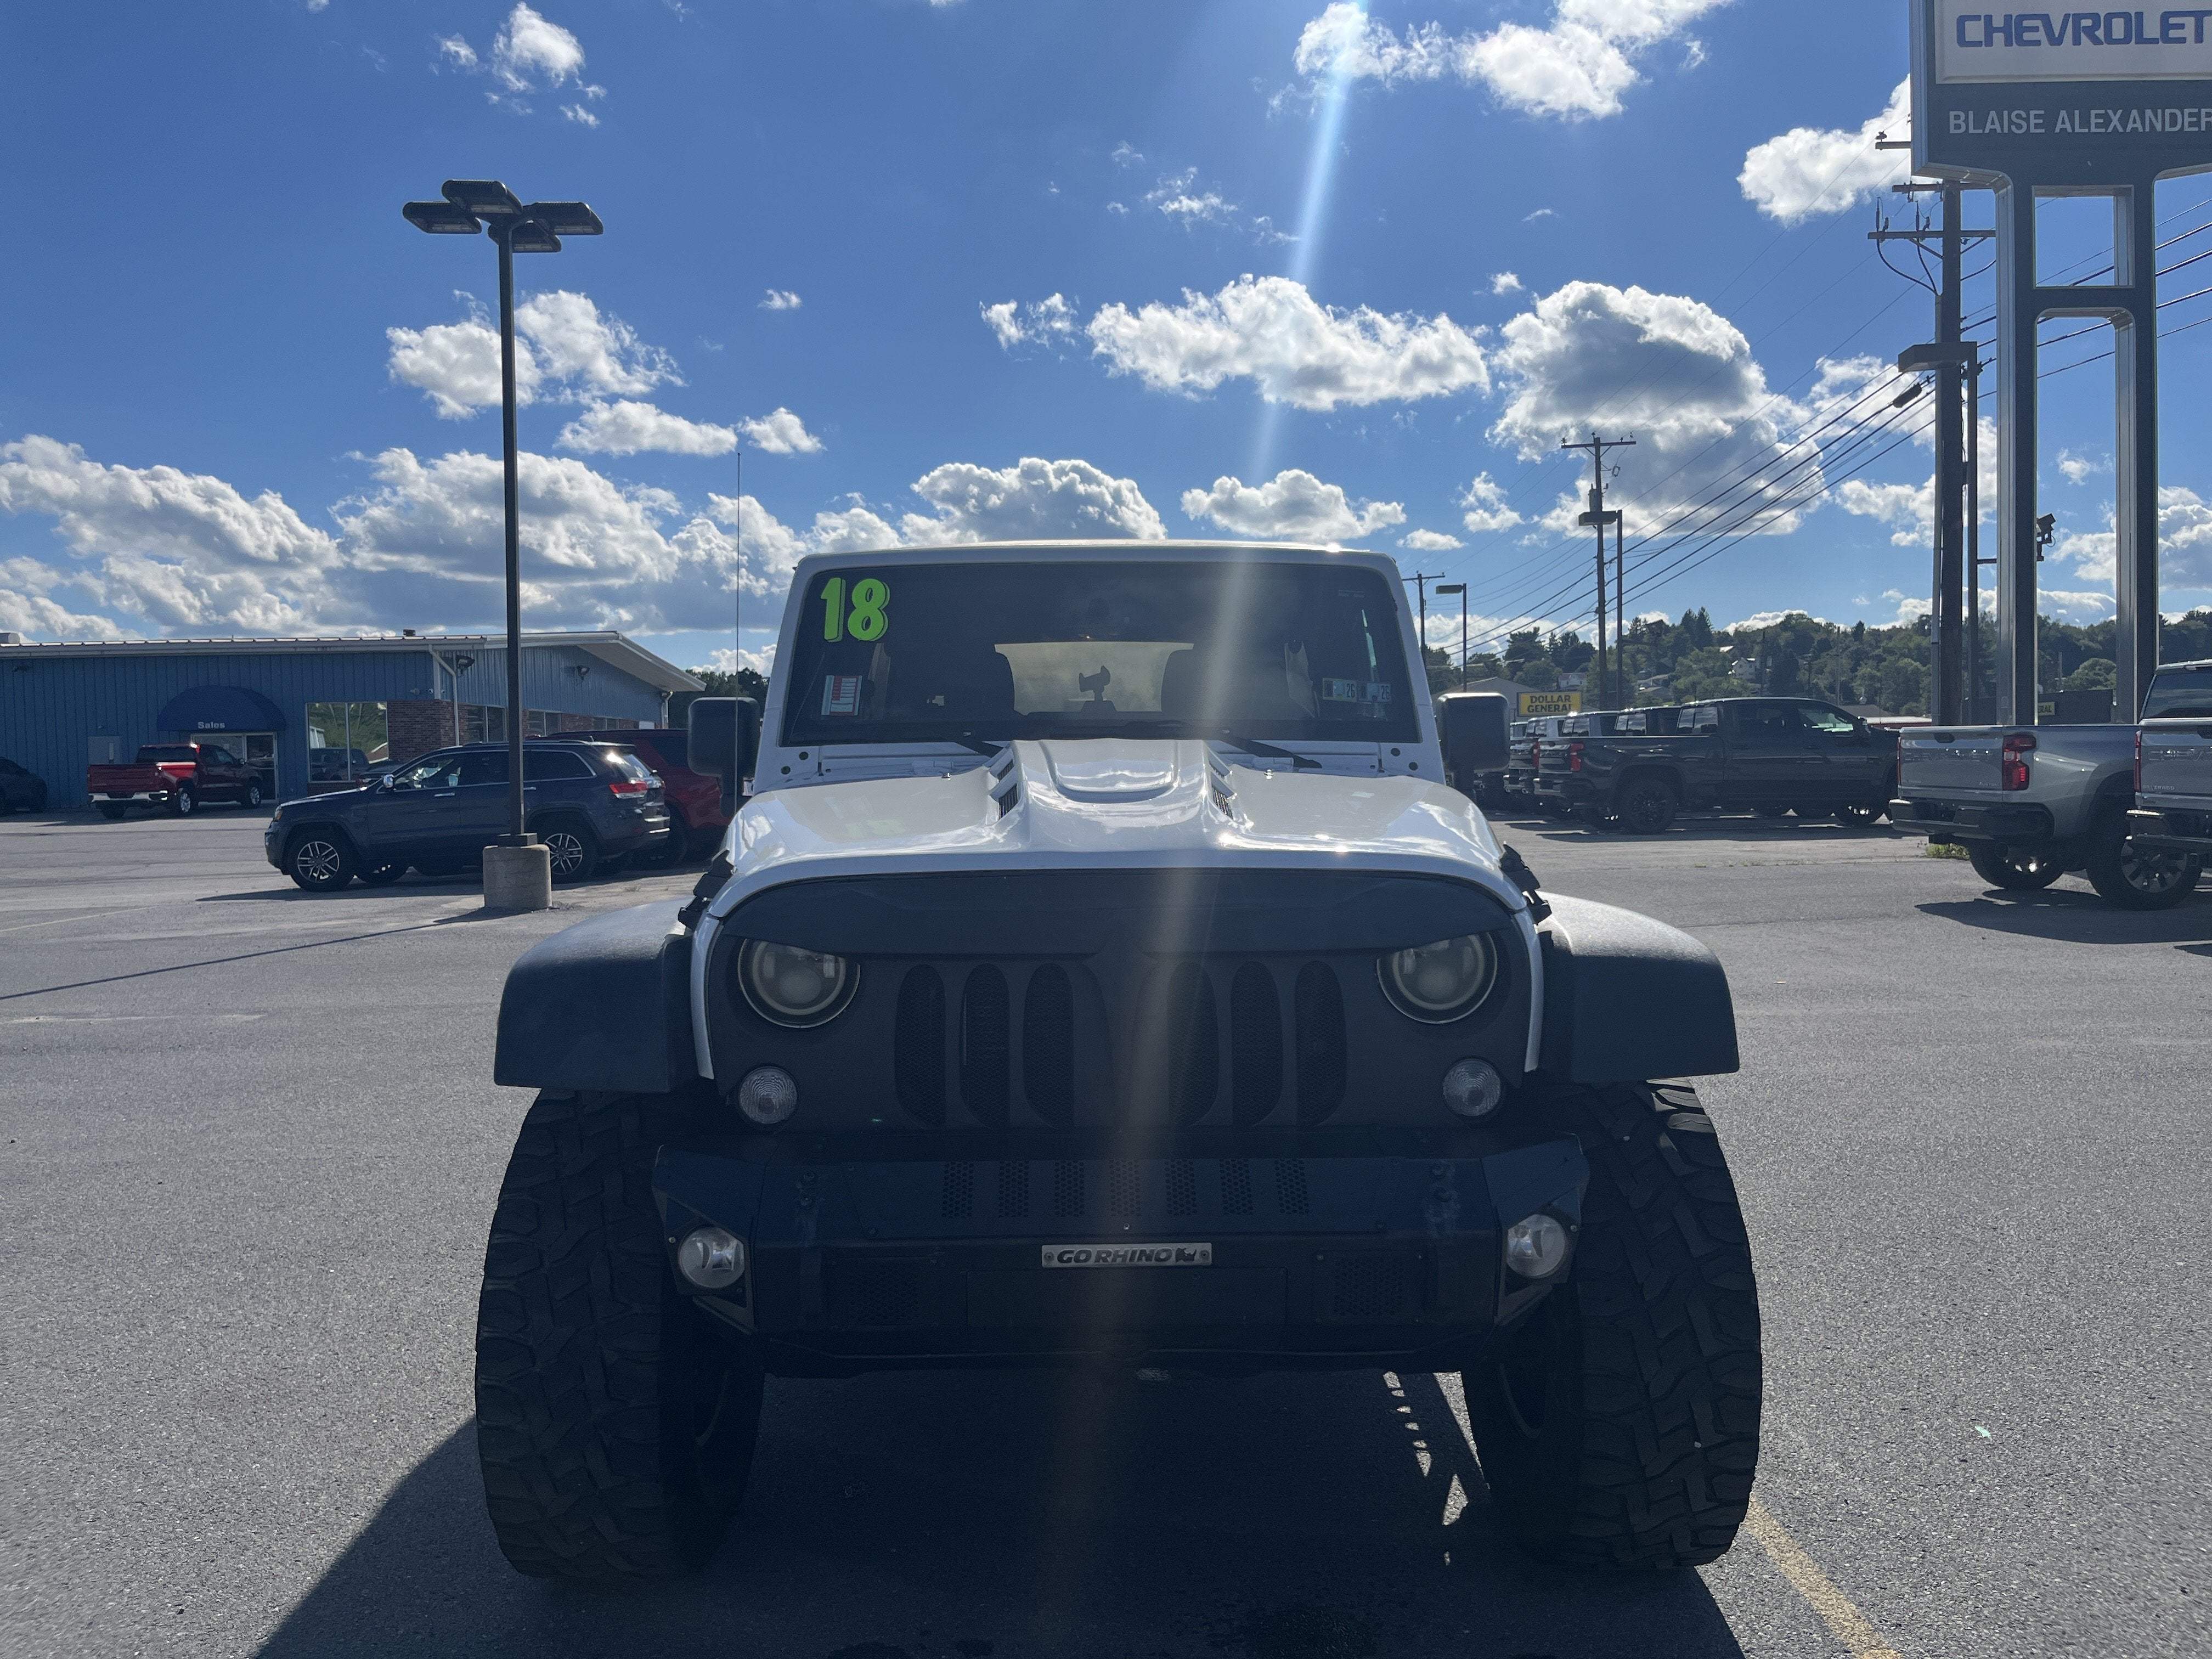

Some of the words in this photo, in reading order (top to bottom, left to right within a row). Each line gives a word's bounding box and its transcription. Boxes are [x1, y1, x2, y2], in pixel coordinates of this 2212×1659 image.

[1956, 10, 2212, 47] CHEVROLET
[1949, 110, 2045, 134] BLAISE
[2055, 108, 2212, 133] ALEXANDER
[821, 578, 890, 642] 18
[1057, 1249, 1092, 1263] GO
[1094, 1248, 1173, 1262] RHINO
